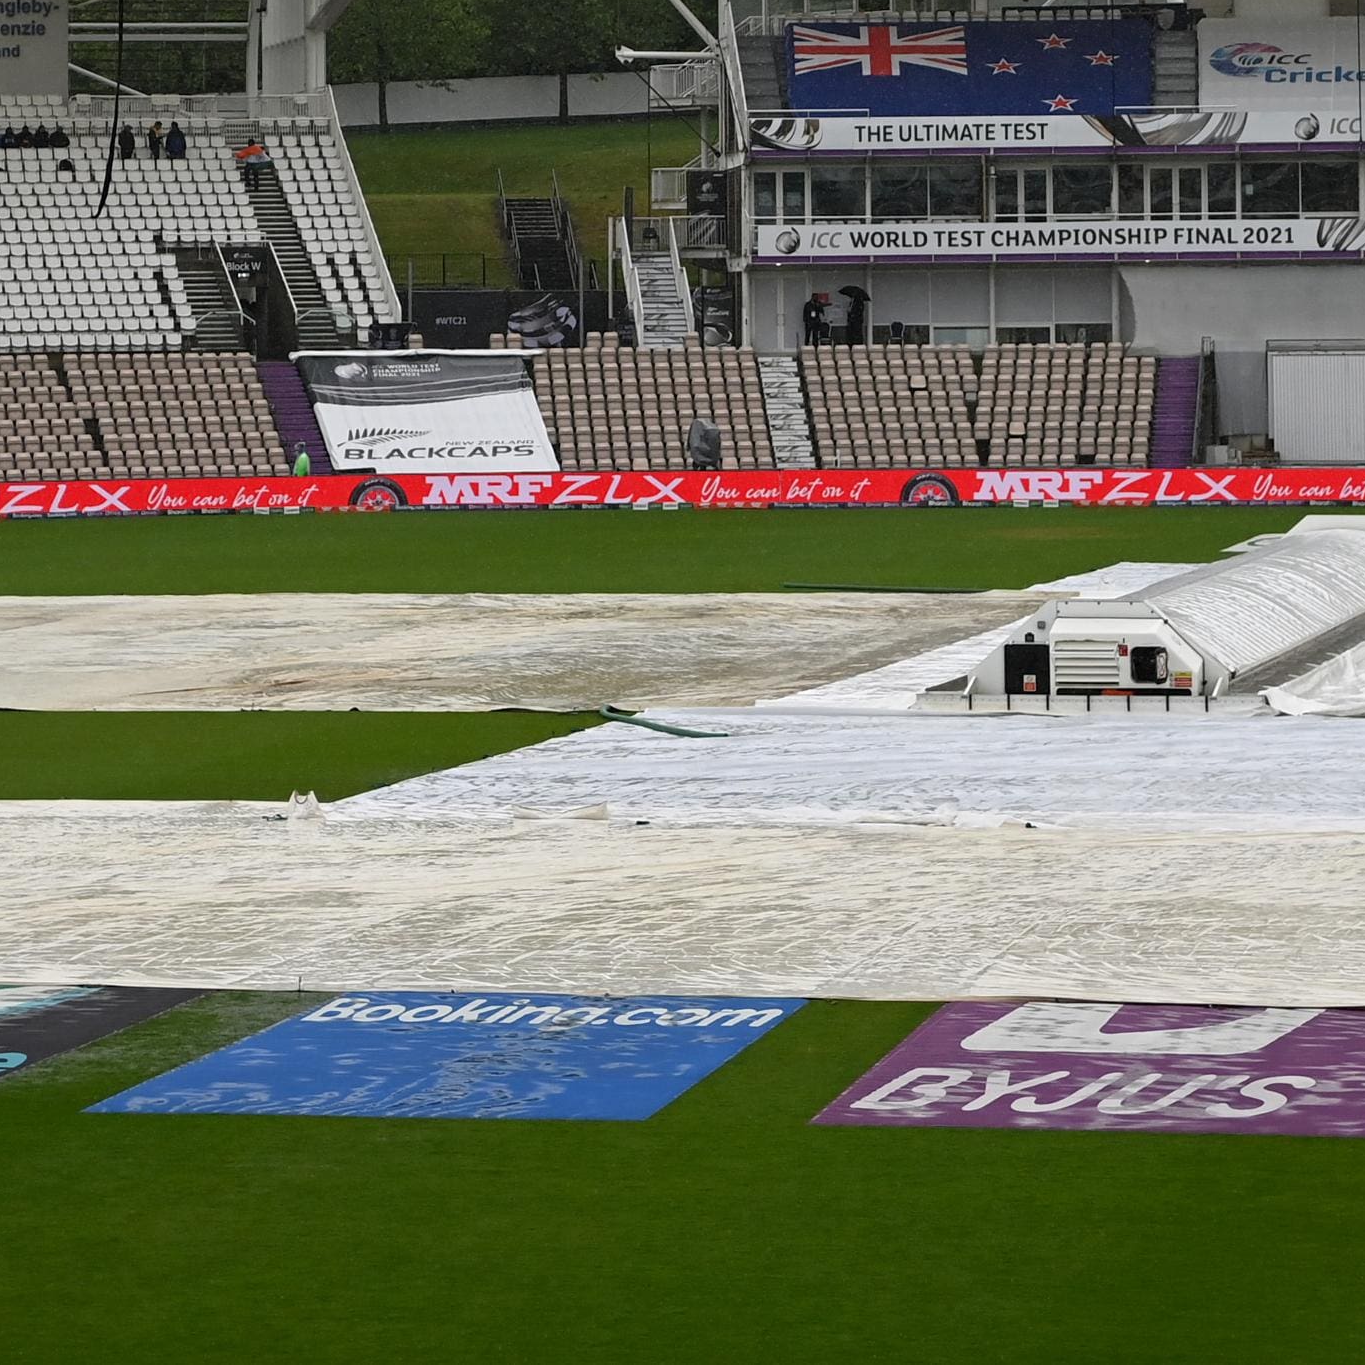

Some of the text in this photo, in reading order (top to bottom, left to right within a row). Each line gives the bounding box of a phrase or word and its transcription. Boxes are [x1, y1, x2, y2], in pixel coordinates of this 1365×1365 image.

[1267, 54, 1312, 65] ICC
[855, 123, 1048, 142] THE ULTIMATE TEST
[1330, 118, 1361, 134] ICC
[810, 227, 1294, 248] ICC WORLD TEST CHAMPIONSHIP FINAL 2021
[226, 262, 261, 271] Block W
[344, 445, 534, 460] BLACKCAPS
[147, 483, 186, 510] You
[191, 493, 226, 507] can
[232, 484, 269, 508] bet
[269, 493, 293, 506] on
[297, 482, 319, 507] it
[422, 476, 552, 504] MRF
[700, 476, 741, 503] You
[744, 487, 779, 500] can
[786, 478, 822, 501] bet
[820, 487, 845, 499] on
[848, 477, 870, 501] it
[972, 472, 1103, 501] MRF
[1252, 473, 1295, 501] You
[1299, 487, 1334, 498] can
[301, 997, 783, 1031] Booking.com
